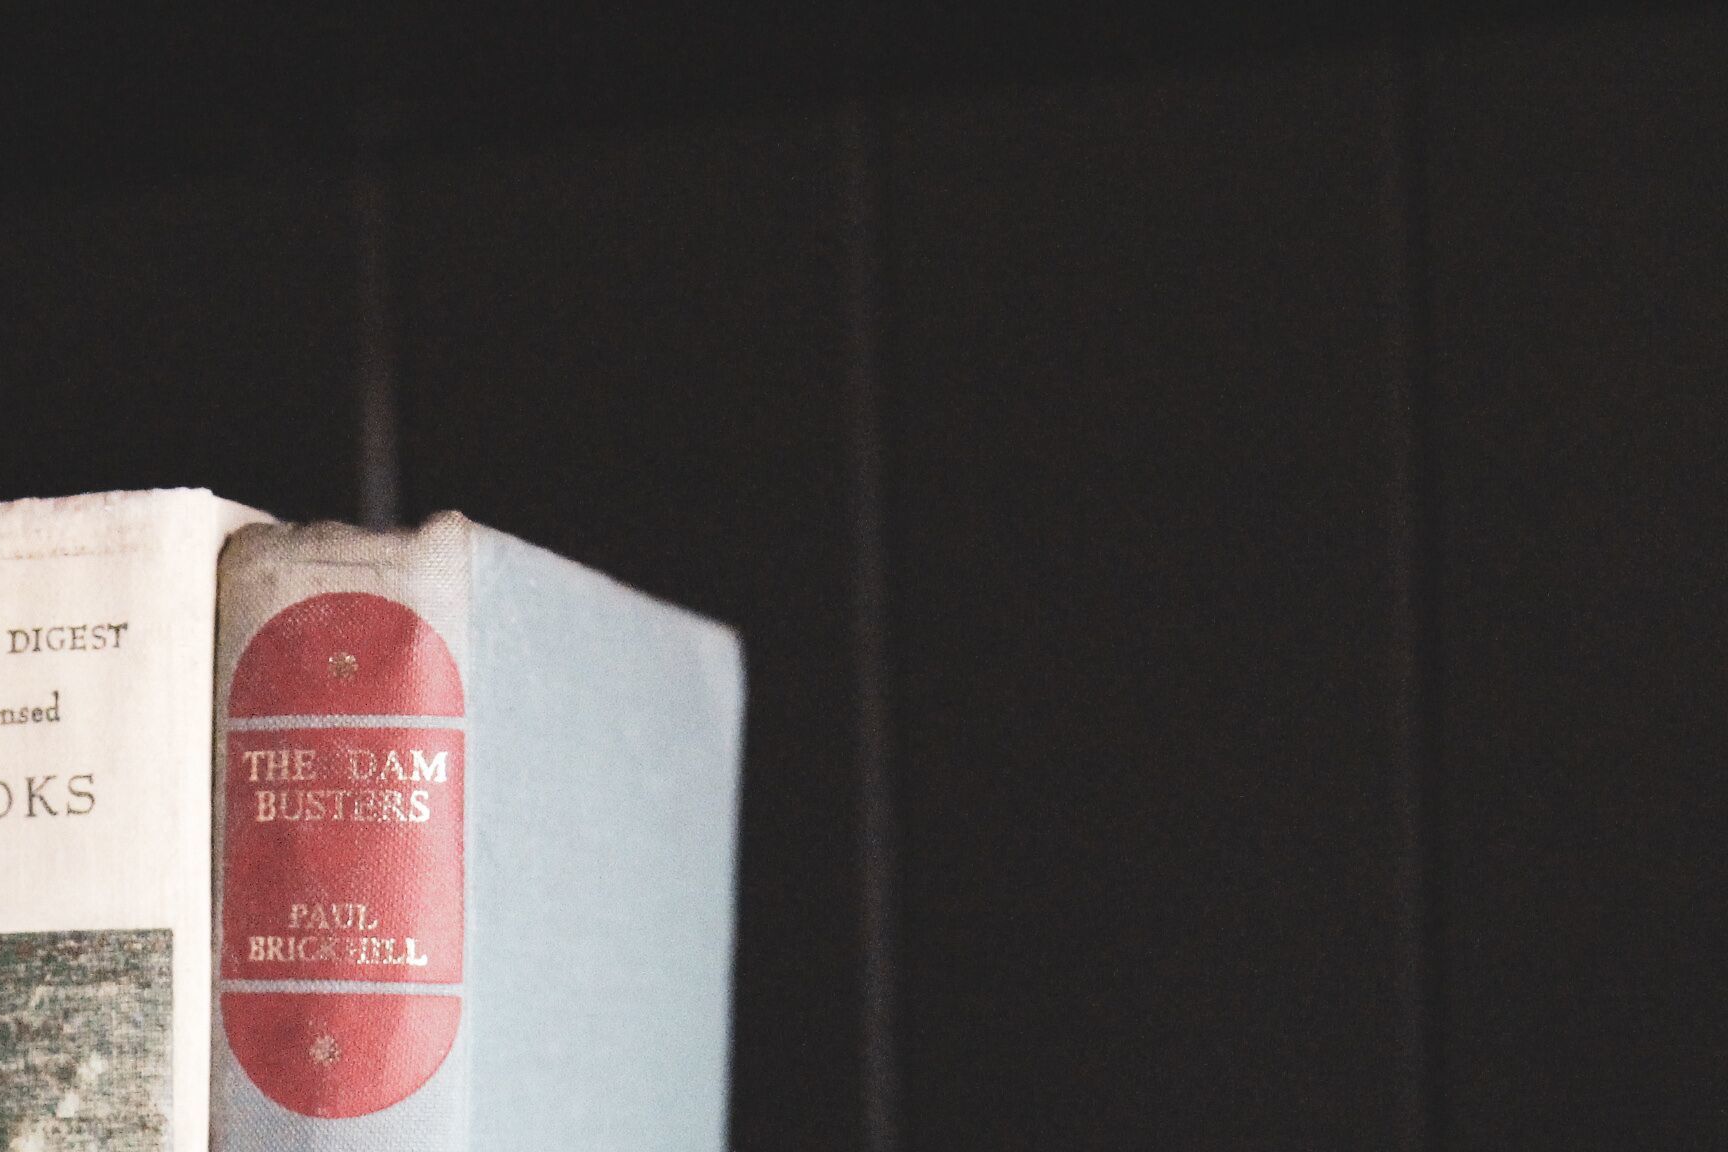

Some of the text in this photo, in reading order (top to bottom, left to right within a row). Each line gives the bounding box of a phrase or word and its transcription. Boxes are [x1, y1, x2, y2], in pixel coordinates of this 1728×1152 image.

[6, 622, 129, 655] DIGEST
[242, 748, 449, 784] THE DAM
[254, 790, 432, 823] BUSTERS
[288, 903, 379, 931] PAUL
